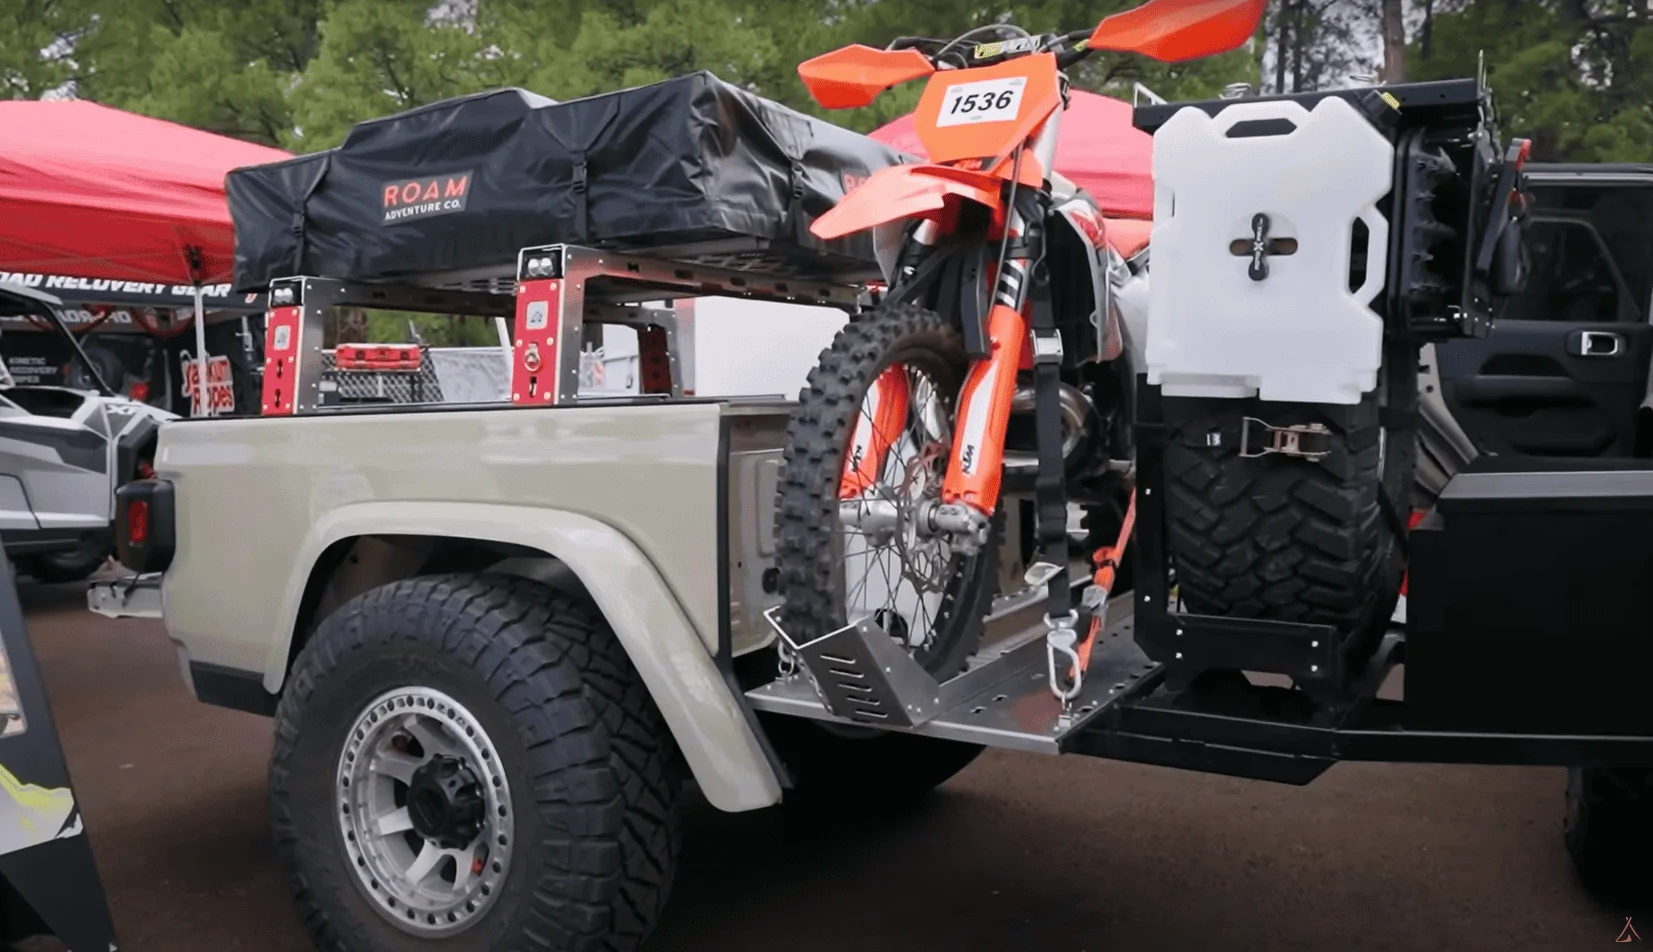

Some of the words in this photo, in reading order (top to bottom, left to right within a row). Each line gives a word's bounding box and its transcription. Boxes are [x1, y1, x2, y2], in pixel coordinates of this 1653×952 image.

[951, 90, 1014, 114] 1536
[384, 176, 468, 208] ROAM
[385, 202, 441, 220] ADVENTURE
[444, 199, 461, 210] CO.
[46, 275, 165, 294] RECOVERY
[171, 284, 231, 297] GEAR
[962, 444, 975, 475] KTM
